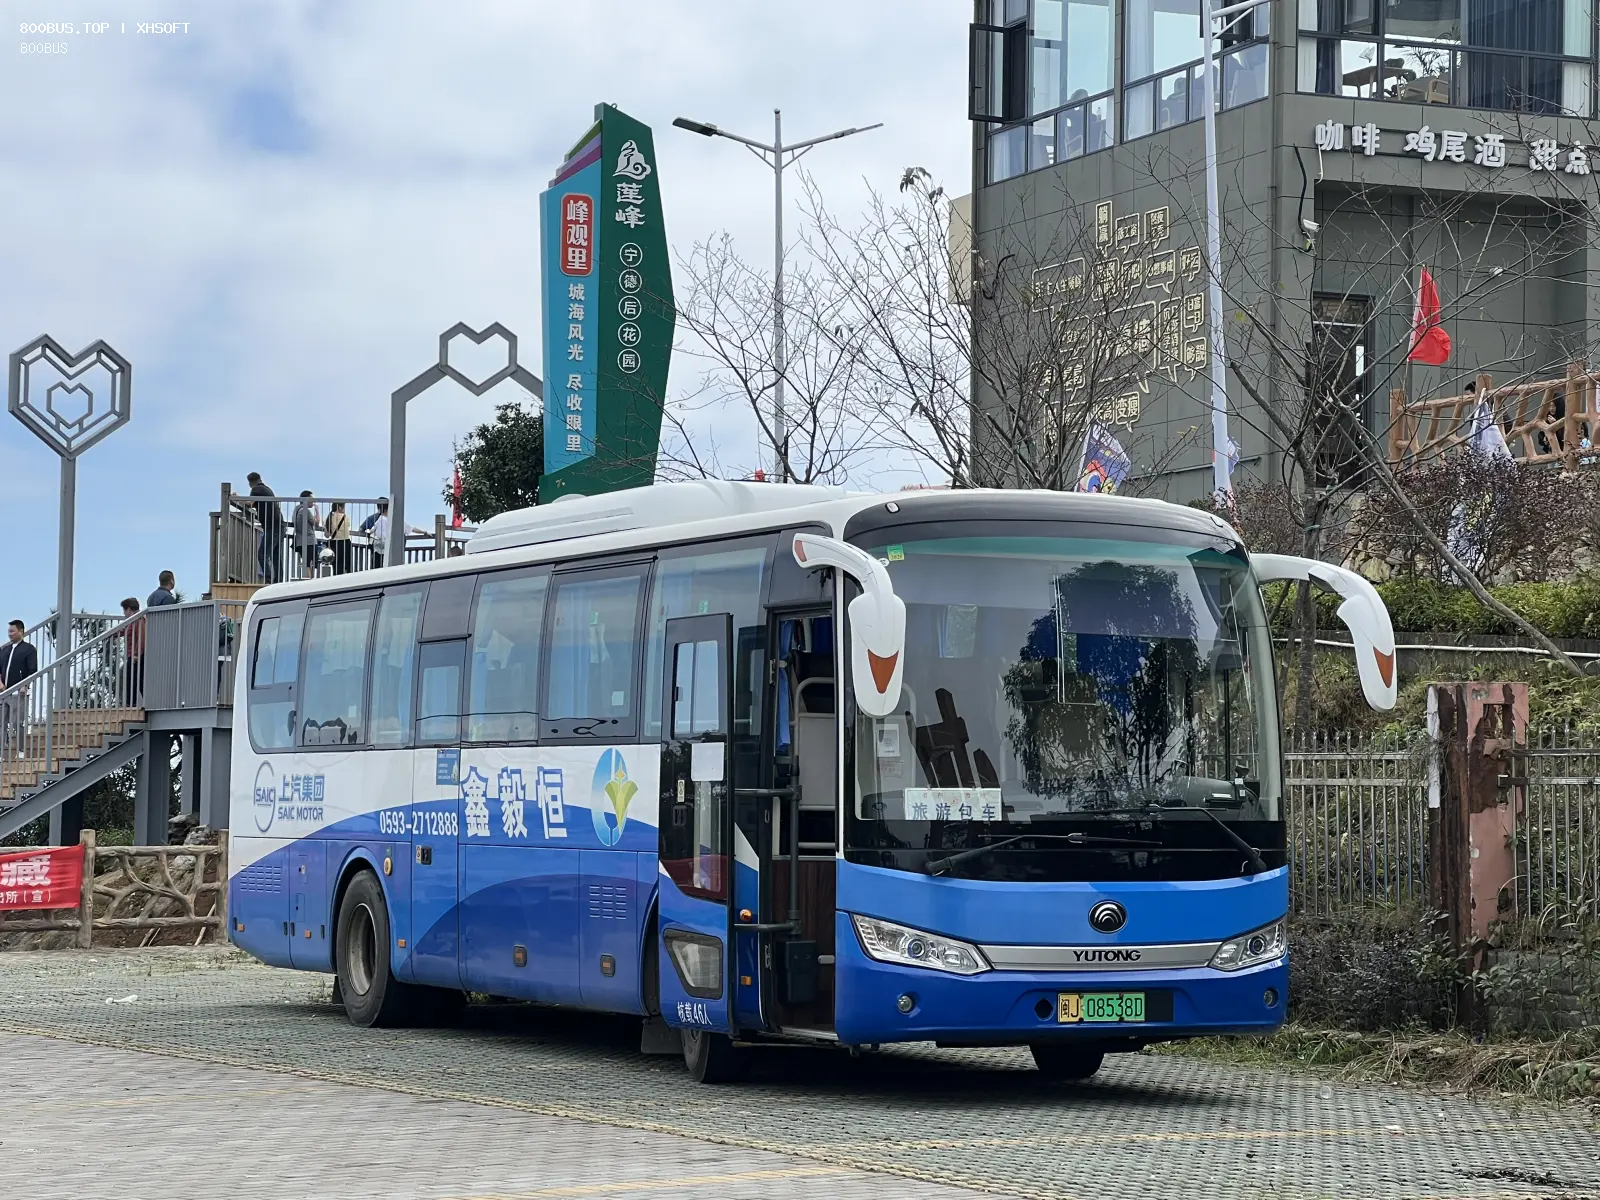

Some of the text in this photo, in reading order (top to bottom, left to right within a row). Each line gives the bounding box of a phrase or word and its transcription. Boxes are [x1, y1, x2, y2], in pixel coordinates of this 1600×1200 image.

[1315, 119, 1381, 156] 咖啡
[1402, 125, 1506, 168] 鸡尾酒
[1529, 139, 1590, 174] 甜点
[567, 200, 588, 270] 峰观里
[567, 284, 584, 361] 城海风光
[619, 245, 641, 370] 宁德后花园
[565, 374, 583, 452] 尽收眼里
[256, 787, 274, 804] SAIC
[279, 774, 325, 801] 上汽集团
[460, 766, 568, 839] 鑫毅恒
[278, 806, 324, 821] SAIC MOTOR
[379, 810, 459, 836] 0593-2712888
[912, 803, 997, 825] 旅游包车
[1073, 950, 1141, 962] YUTONG
[677, 1001, 713, 1026] 核载46人
